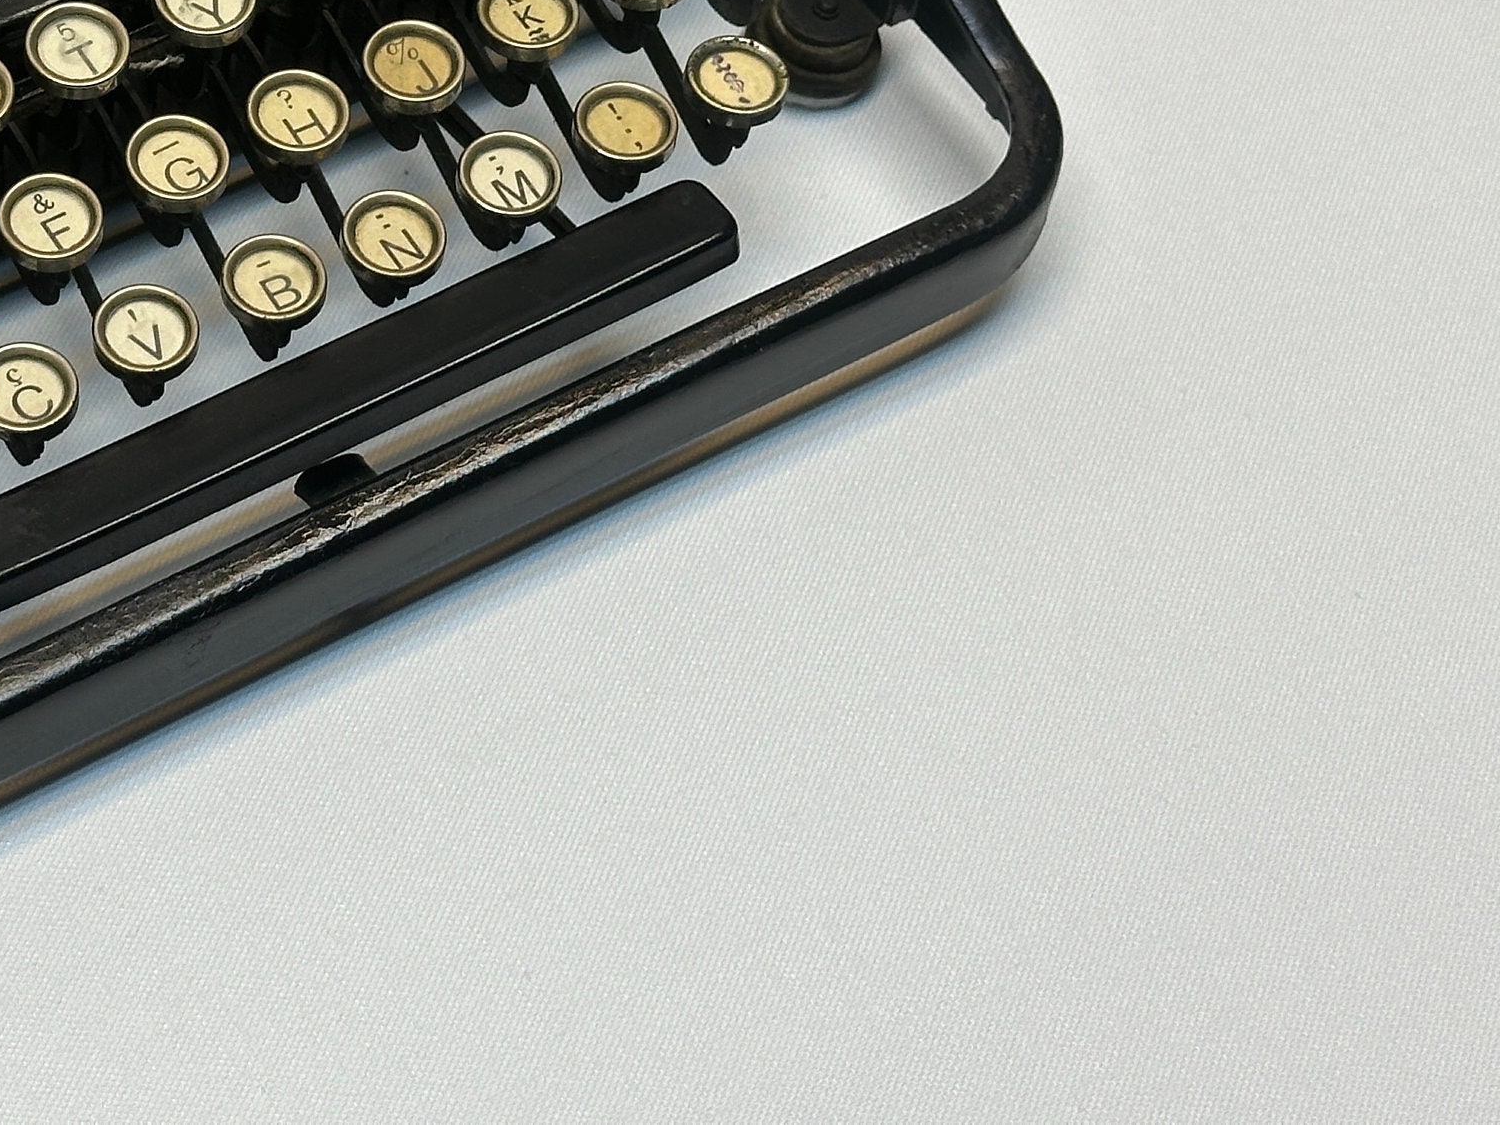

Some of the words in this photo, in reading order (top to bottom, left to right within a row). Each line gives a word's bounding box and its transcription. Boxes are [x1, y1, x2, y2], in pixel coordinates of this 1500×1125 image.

[56, 23, 76, 42] 5
[512, 4, 546, 29] K
[65, 40, 98, 75] T
[386, 38, 419, 65] %
[416, 59, 439, 95] J
[277, 88, 293, 109] ?
[607, 102, 622, 121] !
[282, 107, 328, 145] H
[164, 157, 210, 191] G
[491, 170, 542, 208] M
[33, 193, 55, 215] &
[41, 211, 71, 251] F
[379, 228, 426, 270] N
[259, 274, 302, 311] B
[128, 323, 162, 361] V
[12, 385, 53, 421] C
